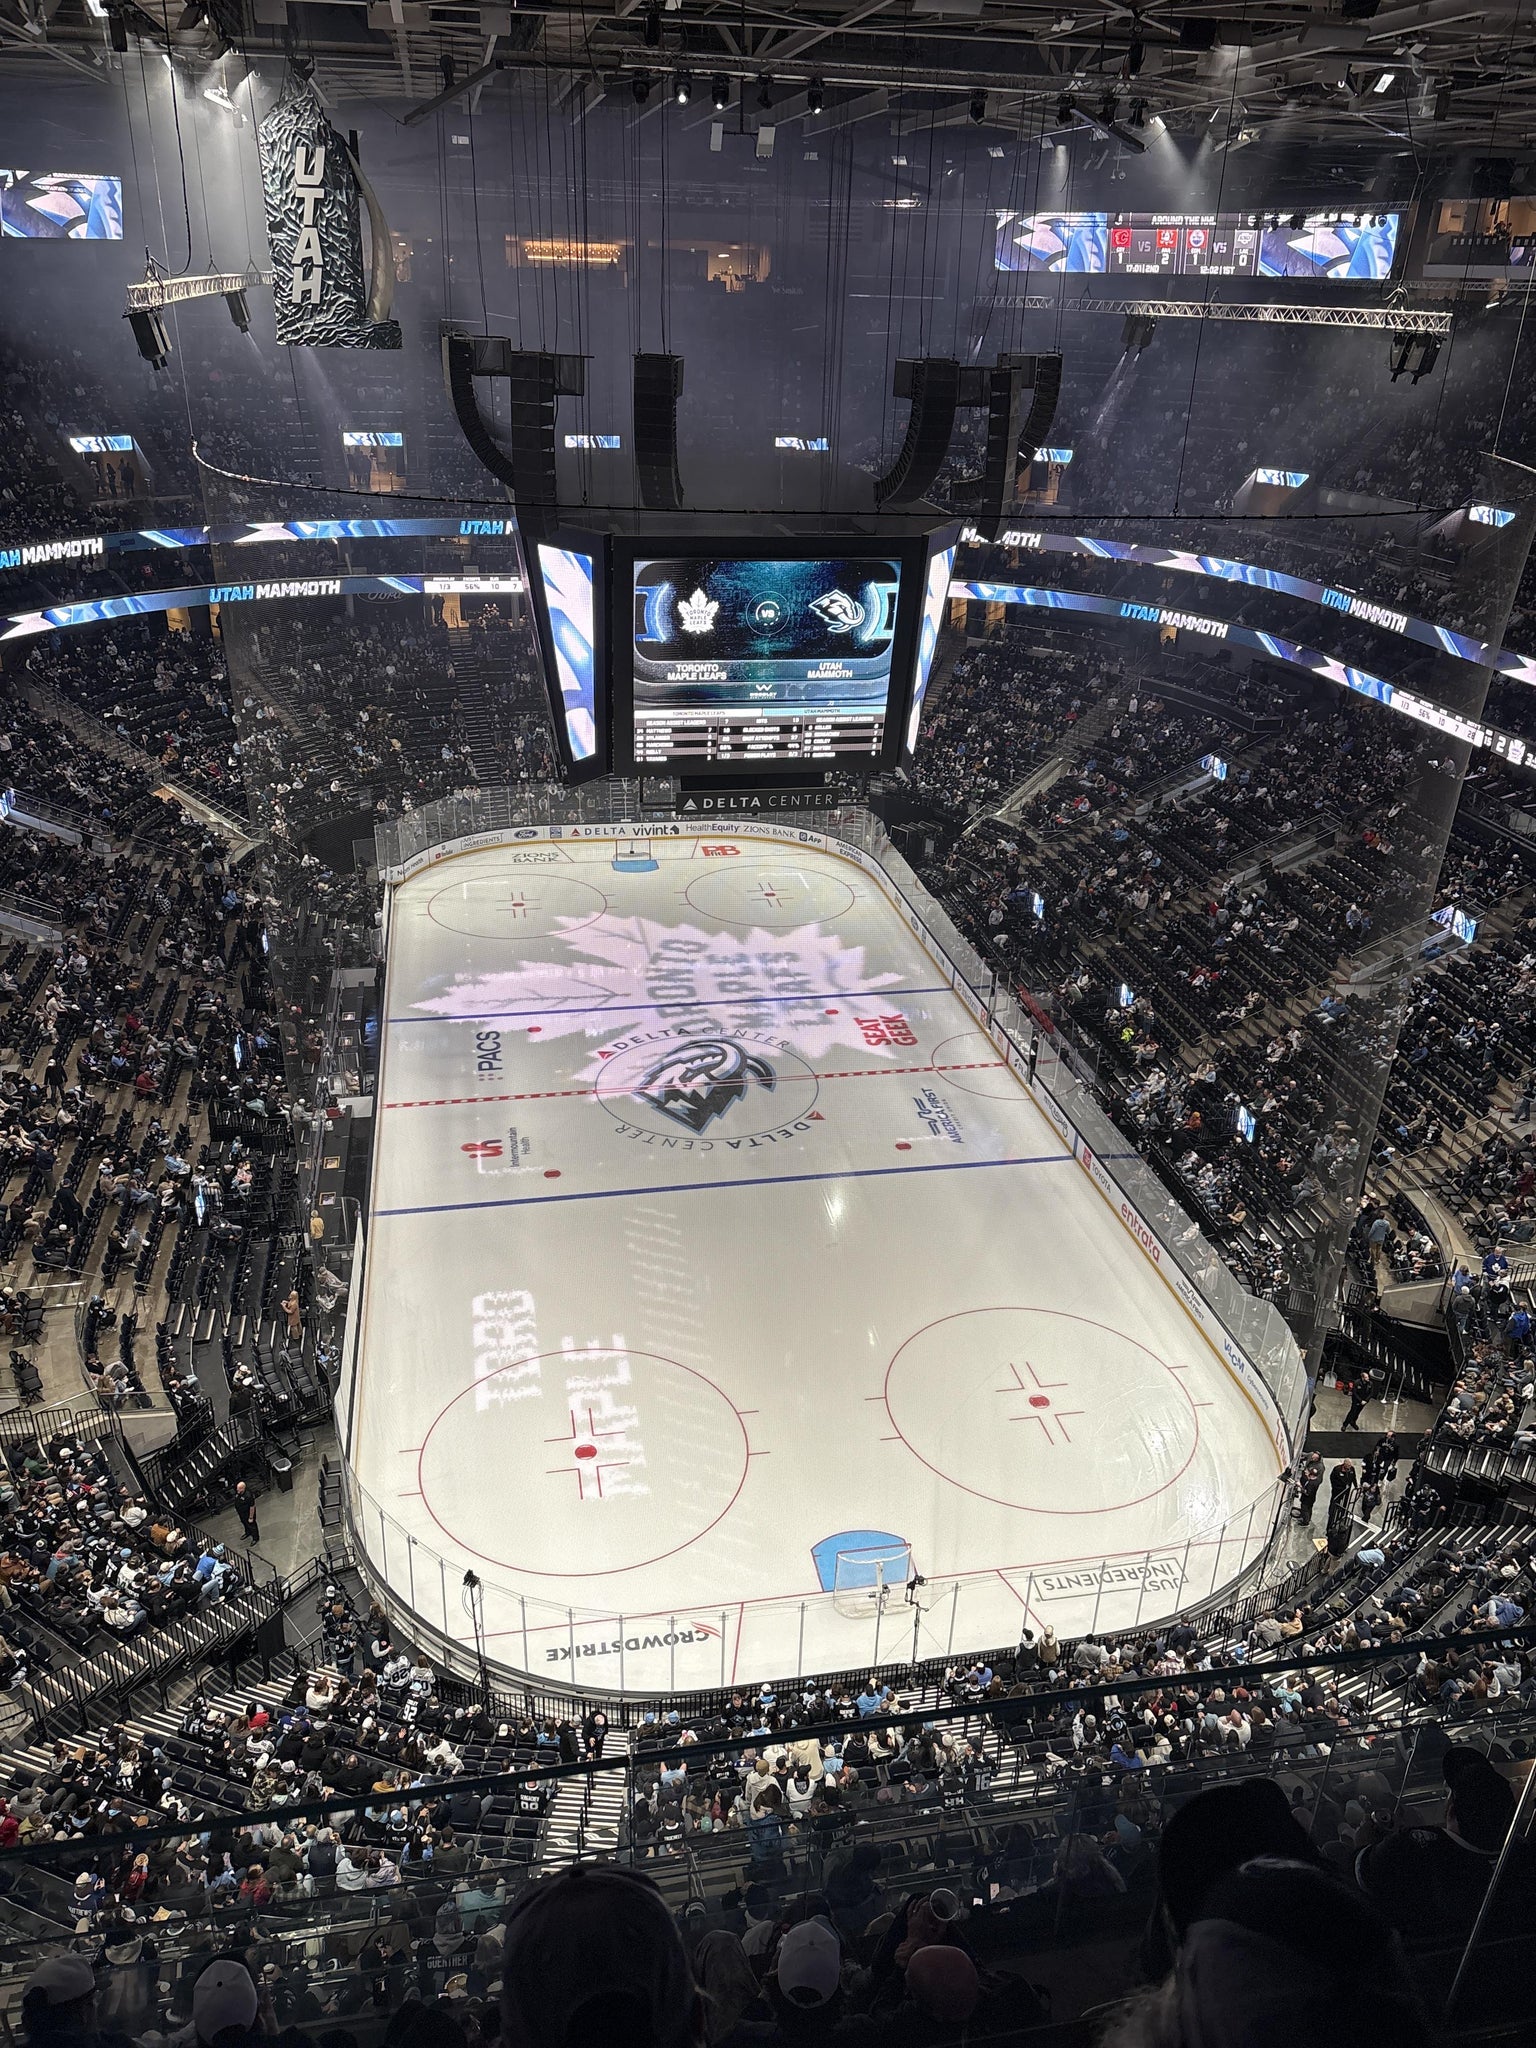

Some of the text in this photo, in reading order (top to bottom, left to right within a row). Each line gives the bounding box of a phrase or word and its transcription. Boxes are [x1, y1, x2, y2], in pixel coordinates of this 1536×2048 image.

[291, 146, 325, 304] UTAH
[1138, 240, 1151, 252] VS
[1118, 252, 1123, 264] 1
[1161, 253, 1170, 265] 2
[1193, 253, 1198, 266] 1
[1239, 255, 1247, 266] 0
[460, 520, 503, 535] UTAH
[0, 538, 103, 570] AH MAMMOTH
[210, 580, 340, 603] UTAH MAMMOTH
[686, 609, 711, 617] TORONTO
[761, 609, 776, 618] VS
[1321, 588, 1408, 633] UTAH MAMMOTH
[1120, 602, 1228, 638] UTAH MAMMOTH
[676, 664, 719, 672] TORONTO
[807, 670, 853, 678] MAMMOTH
[819, 662, 843, 670] UTAH
[667, 671, 728, 680] MAPLE LEAFS
[1495, 735, 1507, 753] 2
[702, 793, 833, 810] DELTA CENTER
[584, 826, 626, 836] DELTA
[633, 824, 669, 836] vivint
[685, 823, 739, 834] HealthEquity
[743, 825, 796, 839] ZIONS BANK
[463, 836, 501, 848] INGREDIENTS
[853, 1017, 892, 1046] SEAT
[879, 1013, 918, 1046] GEEK
[613, 1026, 791, 1051] DELTA CENTER
[475, 1031, 504, 1072] PACS
[921, 1088, 965, 1144] AMERICA FIRST
[615, 1120, 813, 1150] DELTA CENTER
[508, 1127, 519, 1167] Intermountain
[521, 1136, 531, 1154] Health
[1092, 1162, 1111, 1194] TOYOTA
[1121, 1202, 1160, 1264] entrata
[1223, 1338, 1245, 1374] VLCM
[1043, 1562, 1175, 1591] INGREDIENTS
[1142, 1577, 1181, 1593] JUST
[546, 1629, 710, 1662] CROWDSTRIKE
[391, 1667, 409, 1683] 82
[403, 1703, 418, 1722] 92
[974, 1772, 991, 1791] 16
[426, 1955, 468, 1969] GUENTHER
